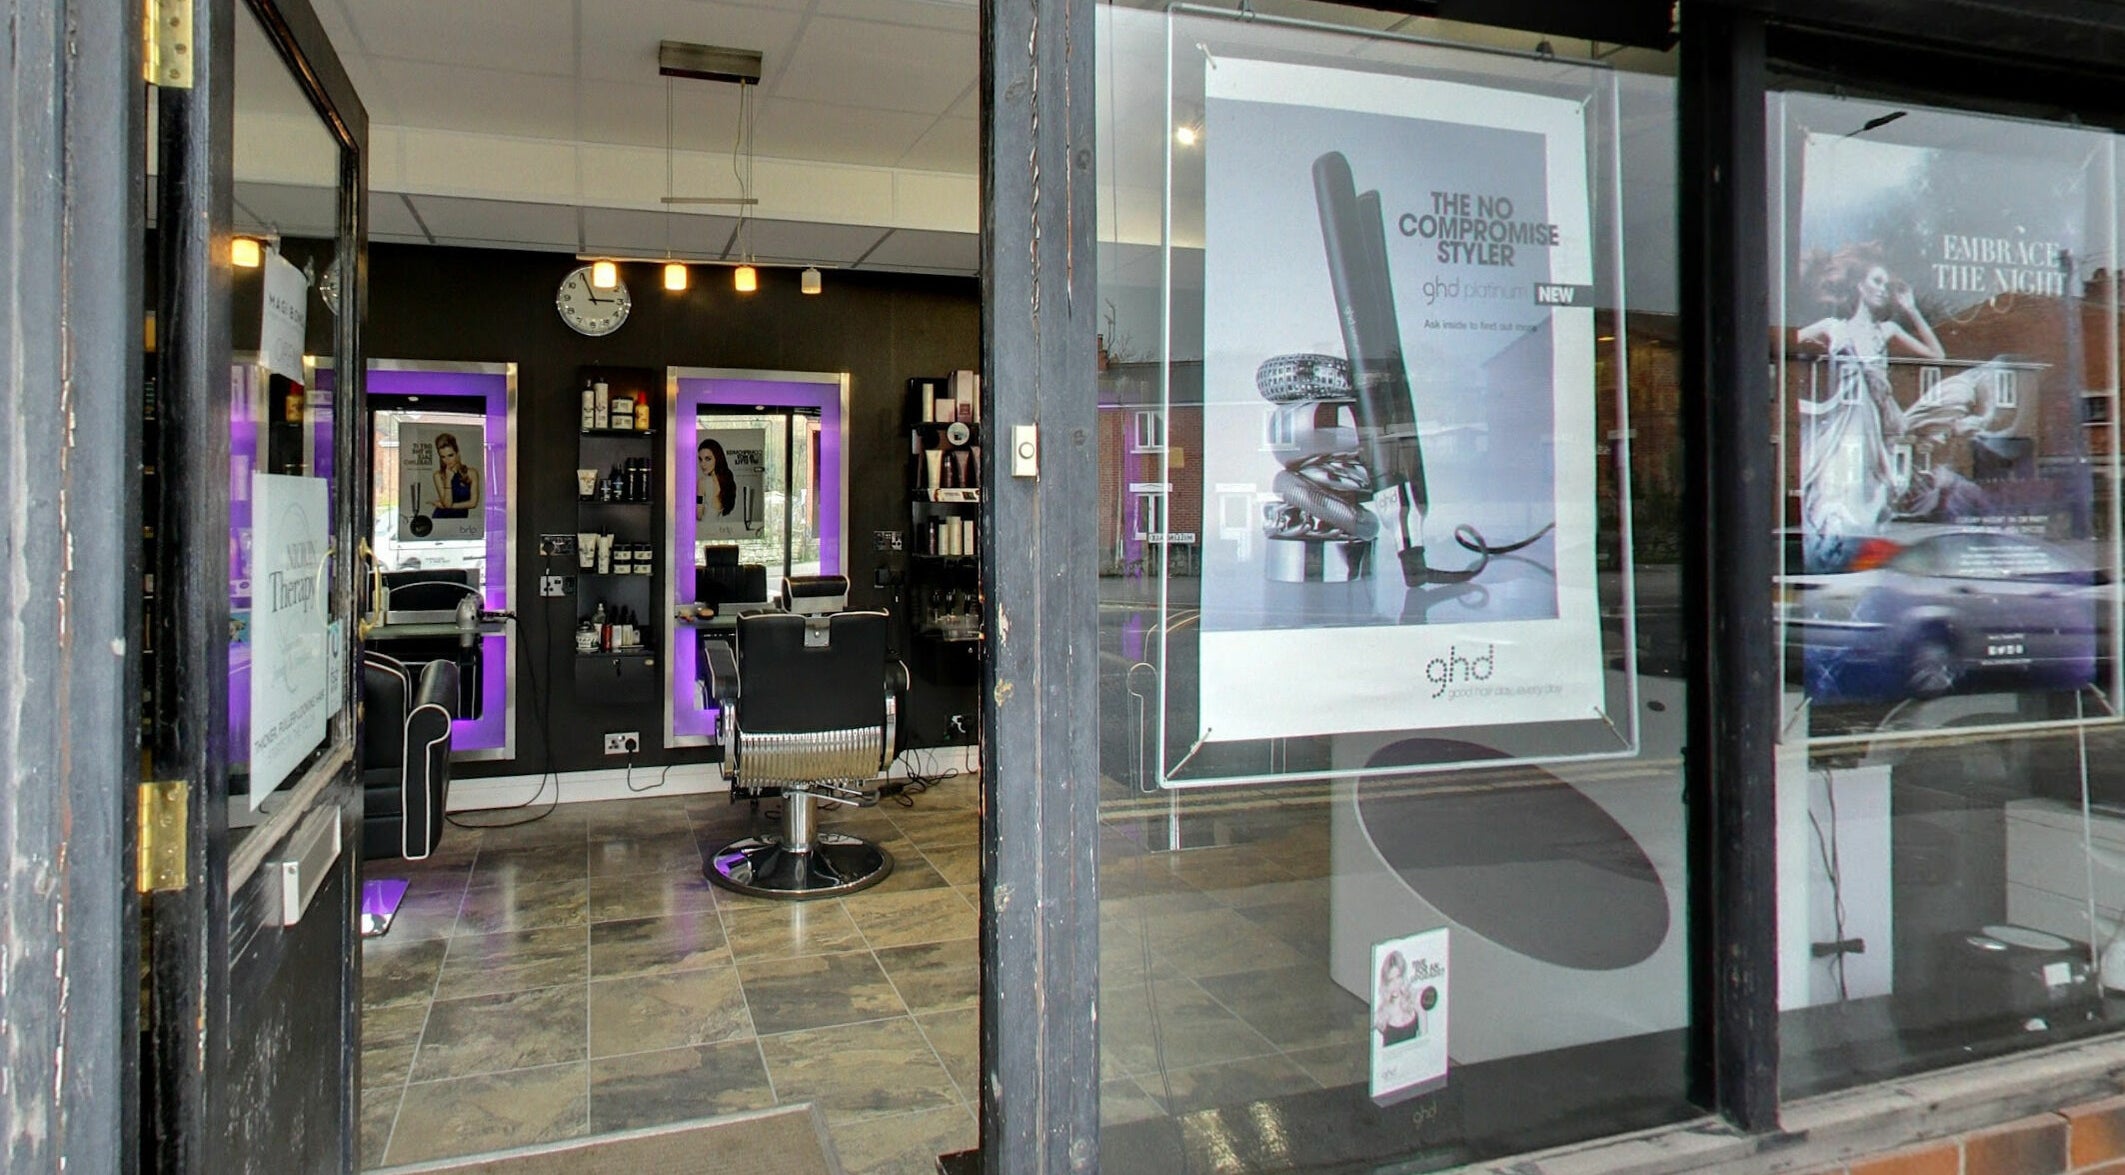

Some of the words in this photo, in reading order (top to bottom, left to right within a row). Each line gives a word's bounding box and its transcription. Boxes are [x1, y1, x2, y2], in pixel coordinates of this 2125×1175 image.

[1430, 191, 1471, 216] THE
[1477, 195, 1514, 220] NO
[1398, 213, 1560, 246] COMPROMISE
[1437, 241, 1515, 266] STYLER
[1943, 234, 2060, 268] EMBRACE
[1423, 275, 1460, 306] ghd
[1538, 286, 1575, 304] NEW
[1932, 263, 1986, 292] THE
[1990, 267, 2068, 297] NIGHT
[1423, 319, 1440, 330] Ask
[1426, 643, 1494, 699] ghd
